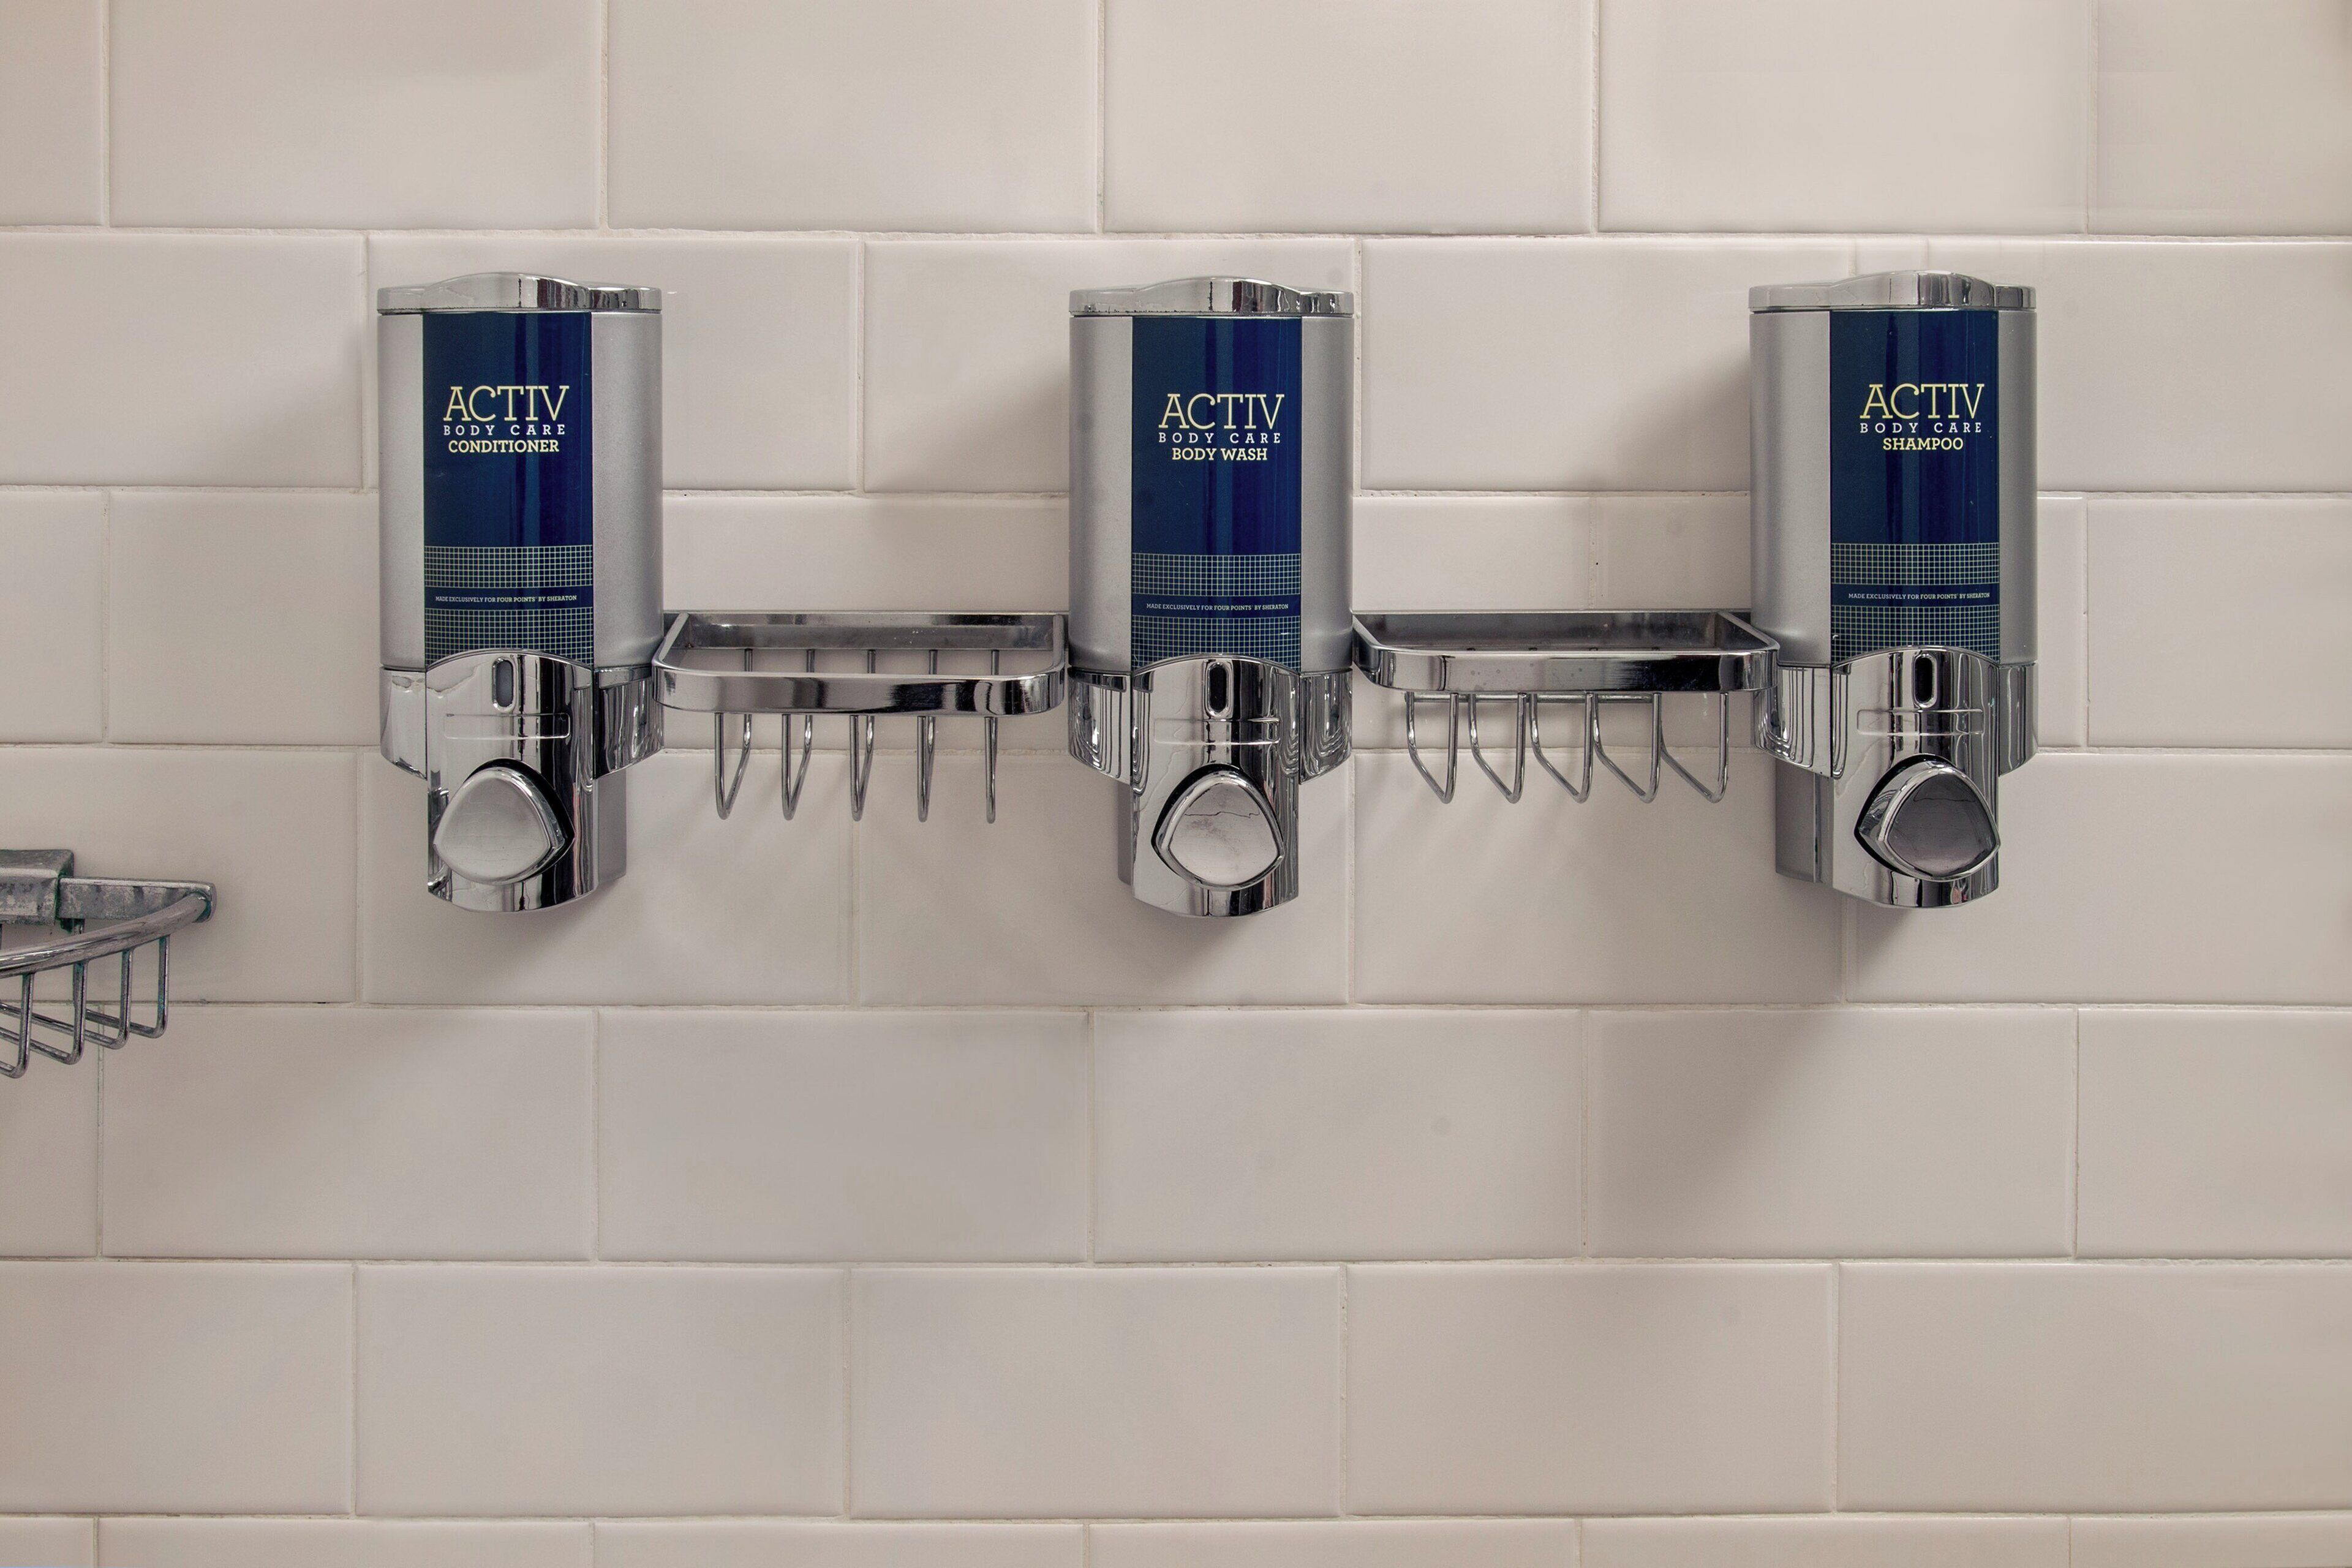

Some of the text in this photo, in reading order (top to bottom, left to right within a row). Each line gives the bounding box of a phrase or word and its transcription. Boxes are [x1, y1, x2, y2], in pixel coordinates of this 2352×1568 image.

[443, 385, 570, 421] ACTIV
[1860, 383, 1985, 419] ACTIV
[1158, 393, 1285, 429] ACTIV
[443, 424, 565, 435] BODY CARE
[1860, 422, 1981, 433] BODY CARE
[1158, 432, 1281, 443] BODY CARE
[1882, 437, 1964, 451] SHAMPOO
[448, 439, 560, 453] CONDITIONER
[1172, 447, 1268, 461] BODY WASH
